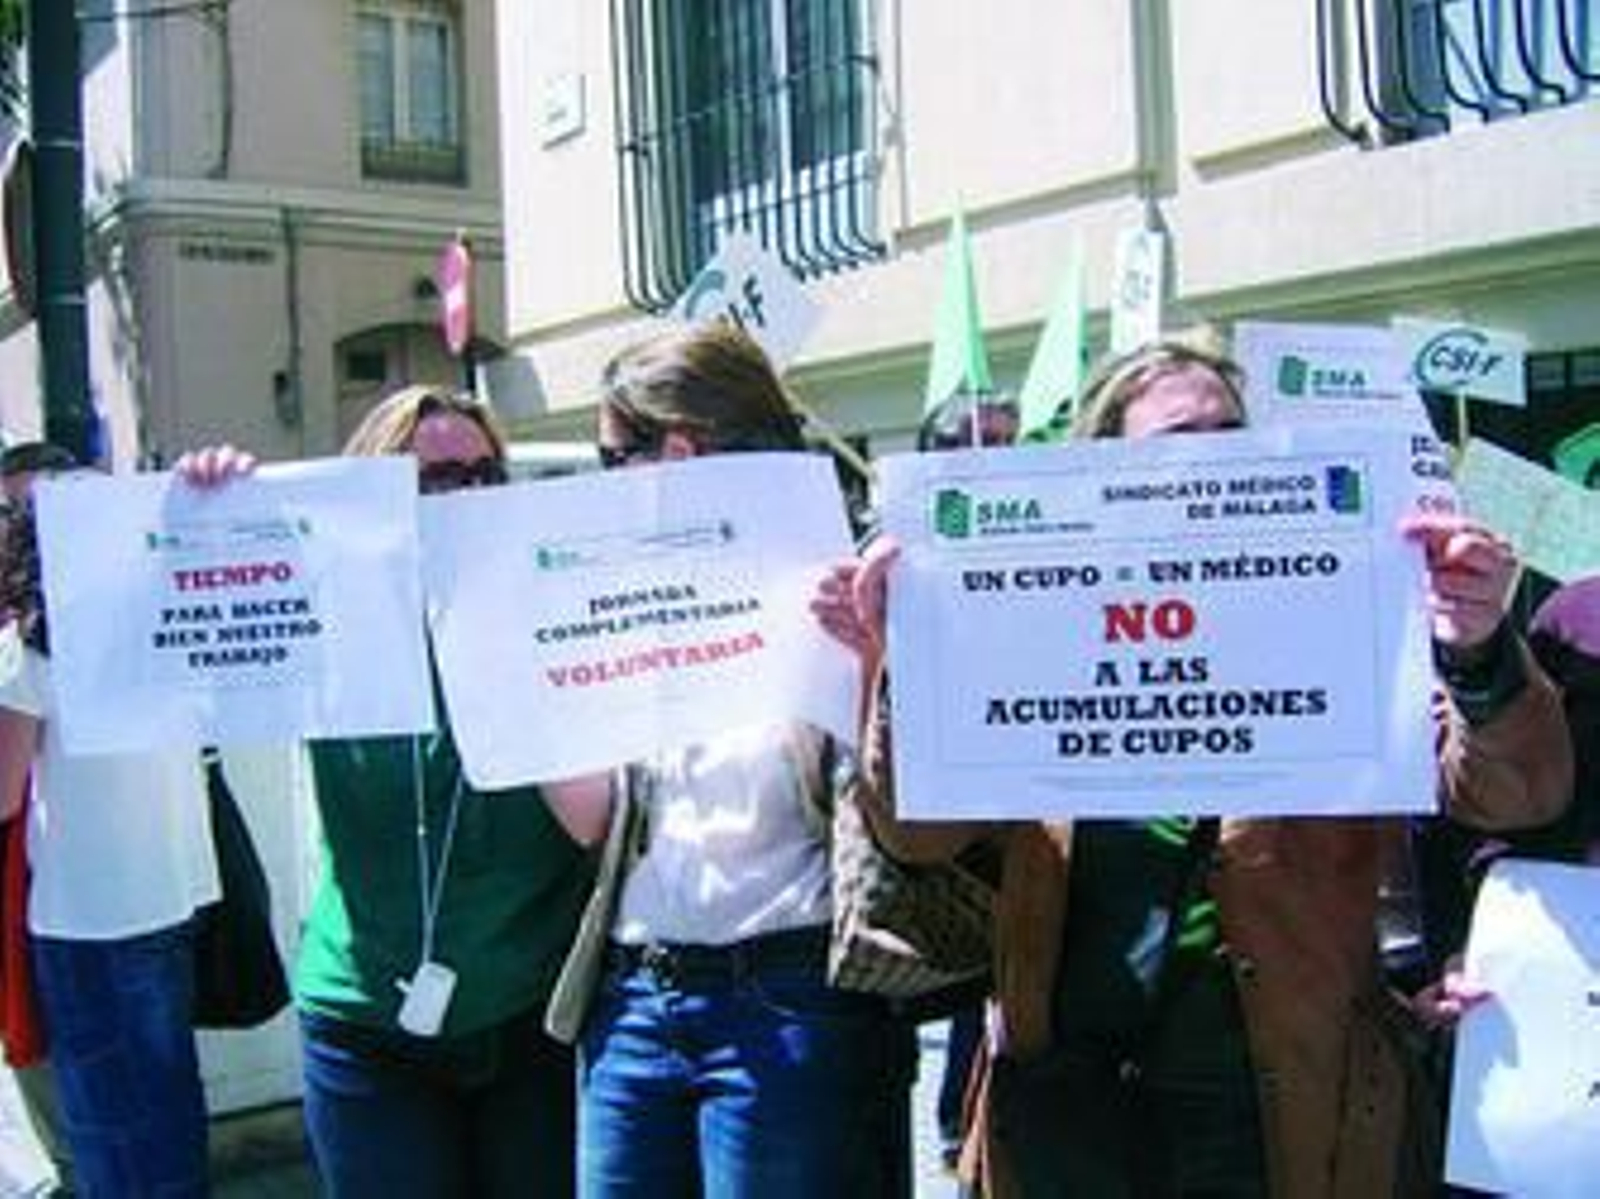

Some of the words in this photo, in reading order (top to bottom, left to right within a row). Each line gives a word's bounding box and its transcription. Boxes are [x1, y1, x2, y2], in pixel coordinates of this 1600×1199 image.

[1103, 480, 1222, 502] SINDICATO
[977, 499, 1042, 524] SMA
[1187, 504, 1215, 520] DE
[174, 562, 292, 591] TIEMPO
[963, 571, 1005, 592] UN
[1014, 565, 1101, 591] CUPO
[1149, 559, 1193, 584] UN
[1200, 552, 1341, 583] MÉDICO
[161, 604, 223, 625] PARA
[232, 599, 309, 619] HACER
[588, 584, 698, 614] JORNADA
[153, 628, 208, 649] BIEN
[217, 619, 322, 643] NUESTRO
[534, 598, 763, 645] COMPLEMENTARIA
[1105, 601, 1196, 642] NO
[188, 646, 288, 669] TRABAJO
[547, 632, 766, 688] VOLUNTARIA
[1094, 661, 1120, 686] A
[1138, 658, 1210, 684] LAS
[985, 689, 1329, 724] ACUMULACIONES
[1057, 732, 1111, 757] DE
[1121, 727, 1254, 755] CUPOS
